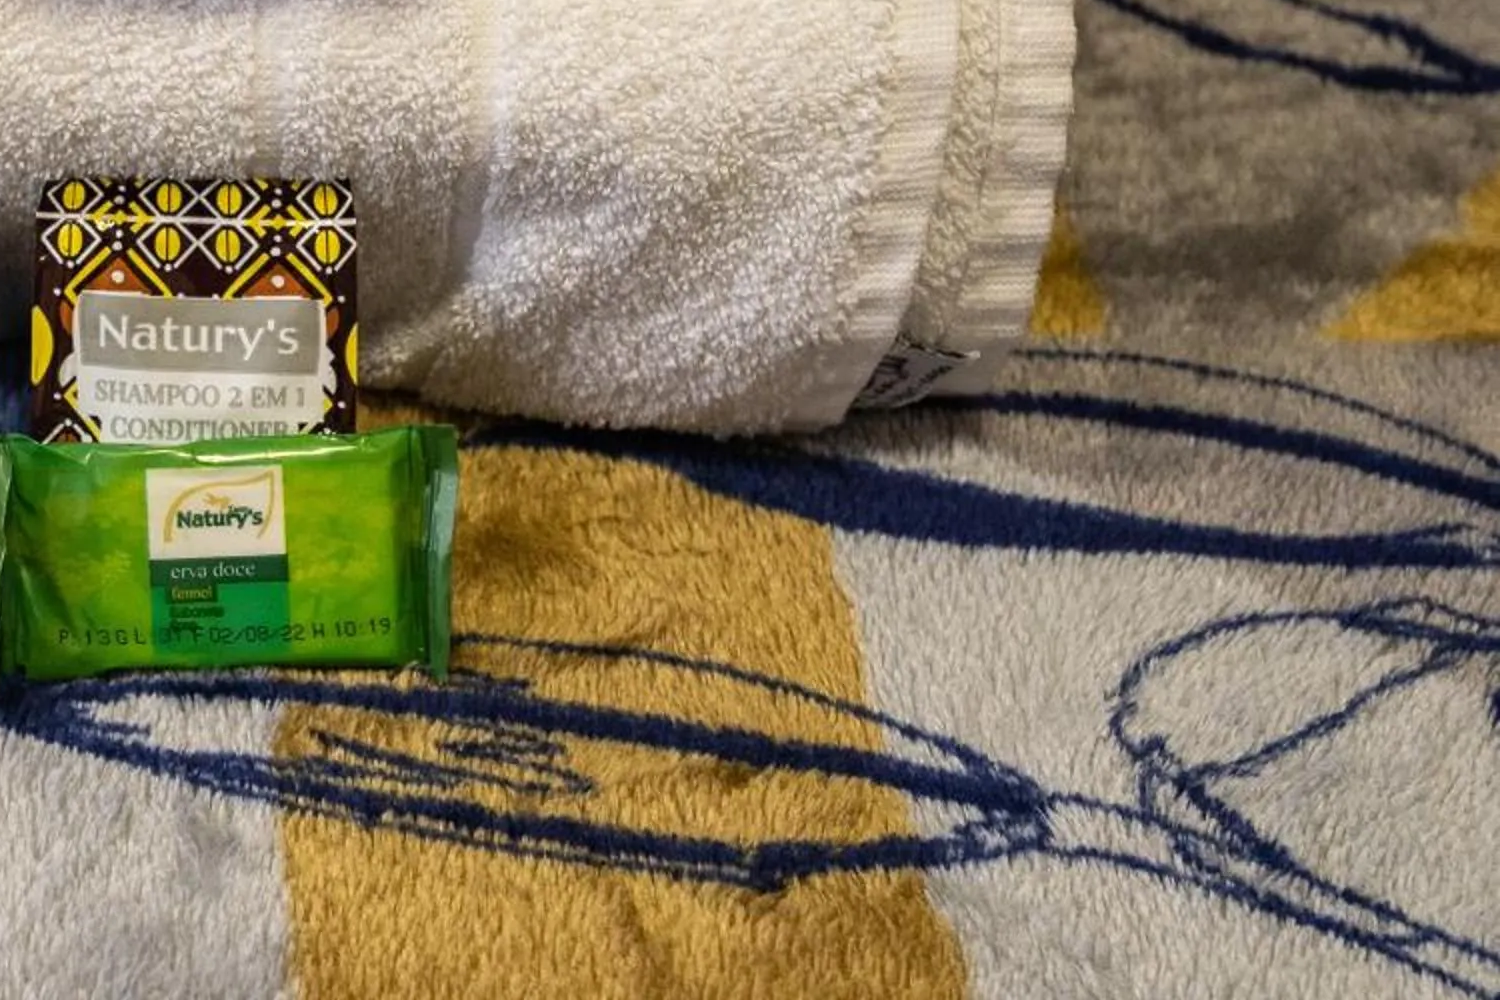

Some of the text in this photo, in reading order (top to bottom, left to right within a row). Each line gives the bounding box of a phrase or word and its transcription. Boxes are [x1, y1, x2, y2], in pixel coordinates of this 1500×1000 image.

[99, 313, 299, 361] Natury's
[94, 379, 306, 409] SHAMPOO 2 EM 1
[176, 508, 264, 530] Natury's
[170, 561, 257, 579] erva doce
